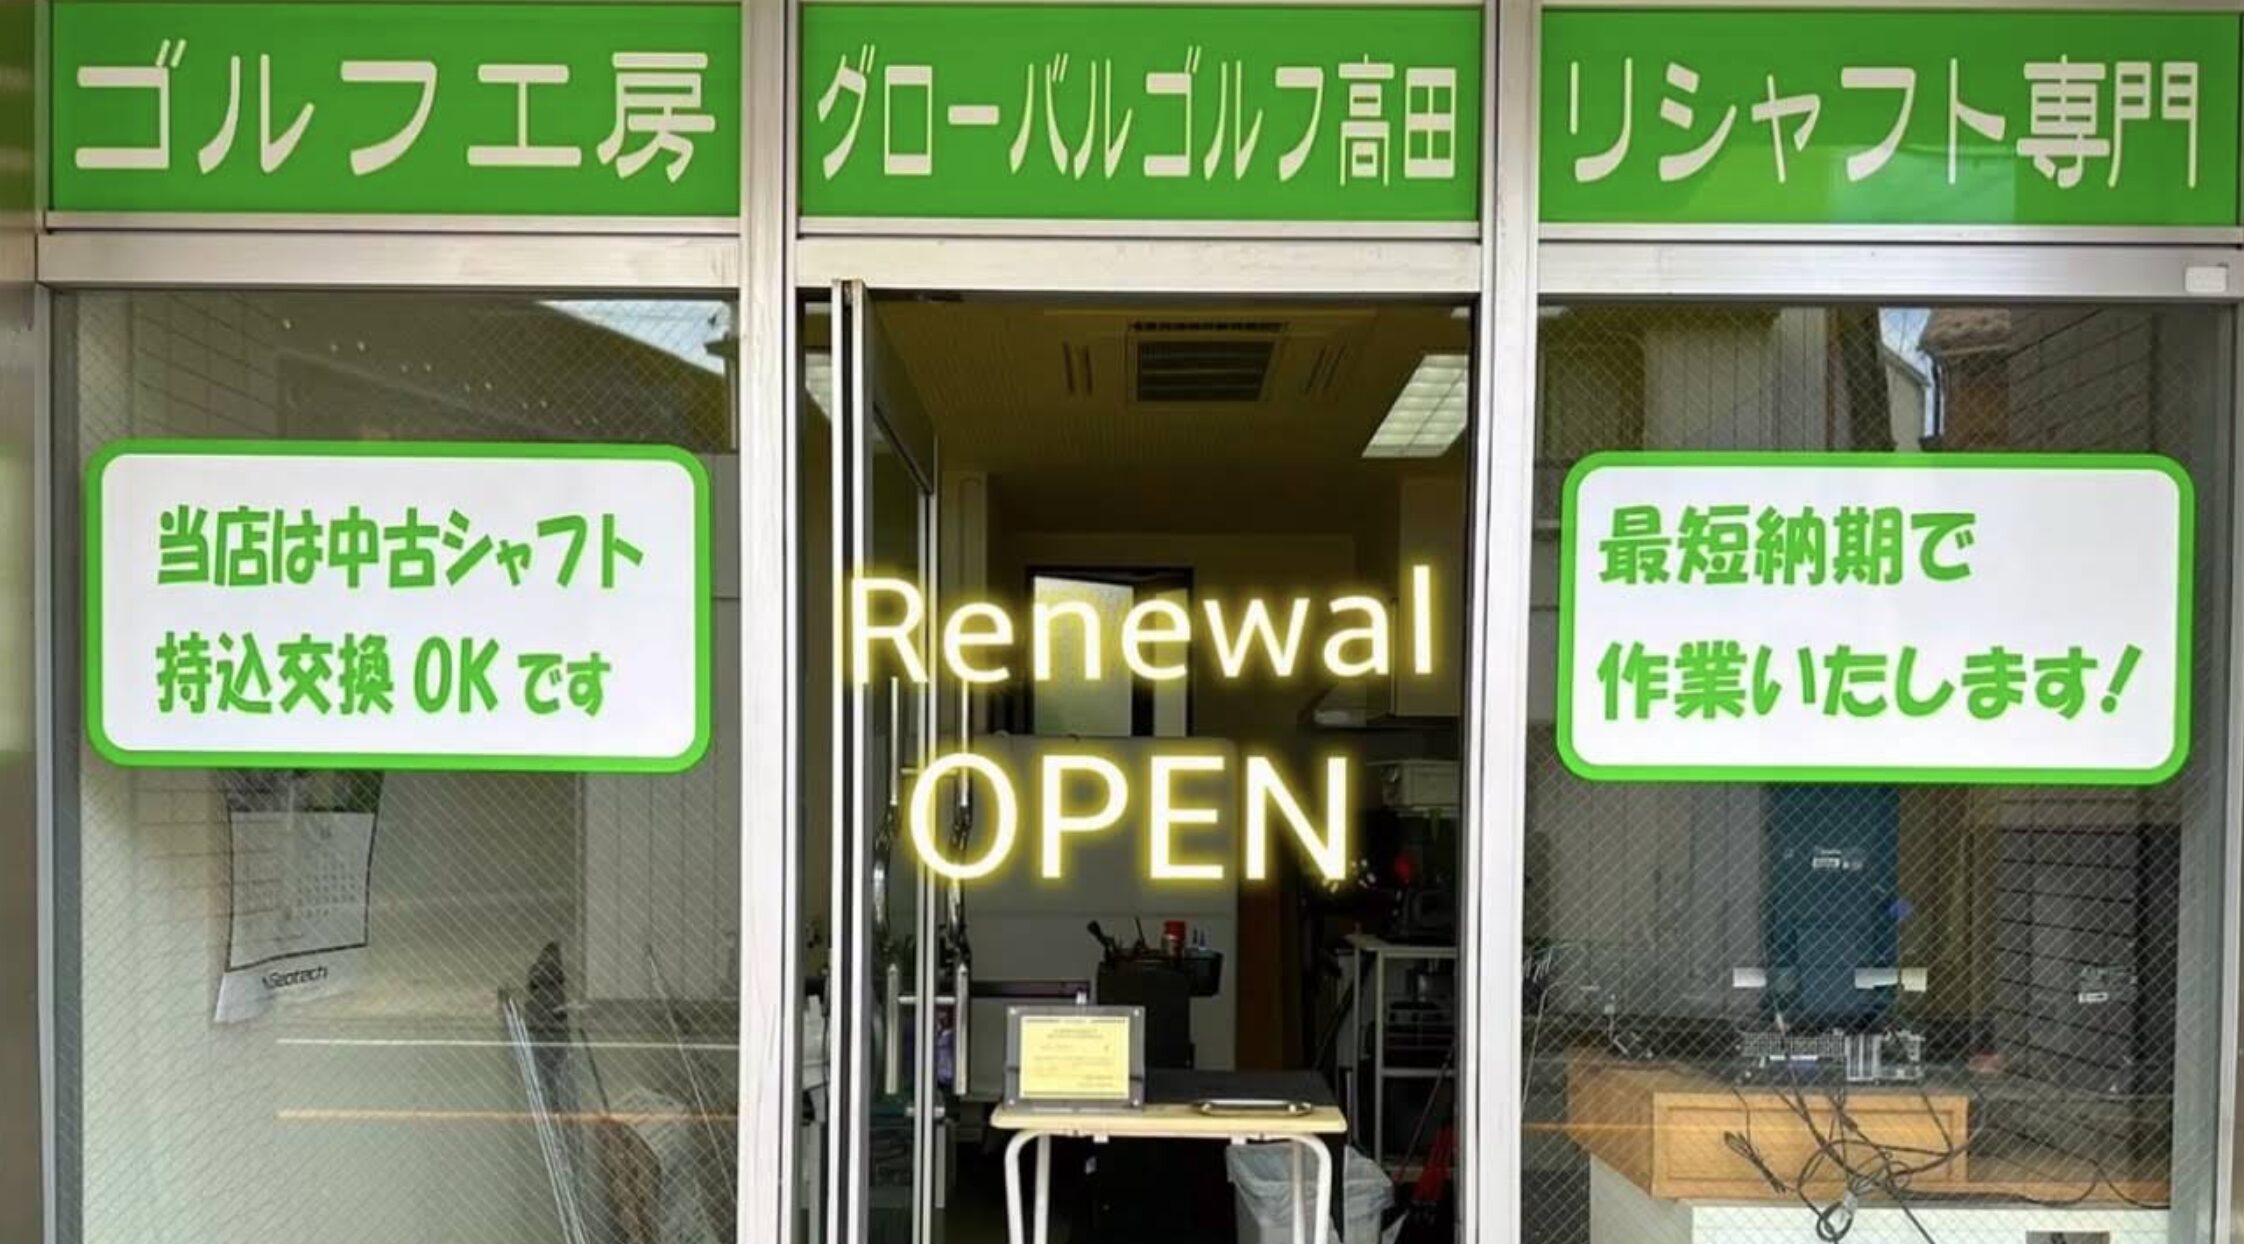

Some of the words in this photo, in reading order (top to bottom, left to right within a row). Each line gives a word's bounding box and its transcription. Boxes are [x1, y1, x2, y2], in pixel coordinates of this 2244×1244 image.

[76, 39, 716, 183] ゴルフ工房
[818, 44, 1457, 187] グローバルゴルフ高田
[1568, 55, 2200, 188] リシャフト専門
[158, 505, 644, 590] 当店は中古シャフト
[1598, 504, 1977, 586] 最短納期で
[156, 632, 395, 716] 持込交換
[413, 636, 500, 715] OK
[518, 651, 611, 716] です
[1596, 640, 2142, 721] 作業いたします!
